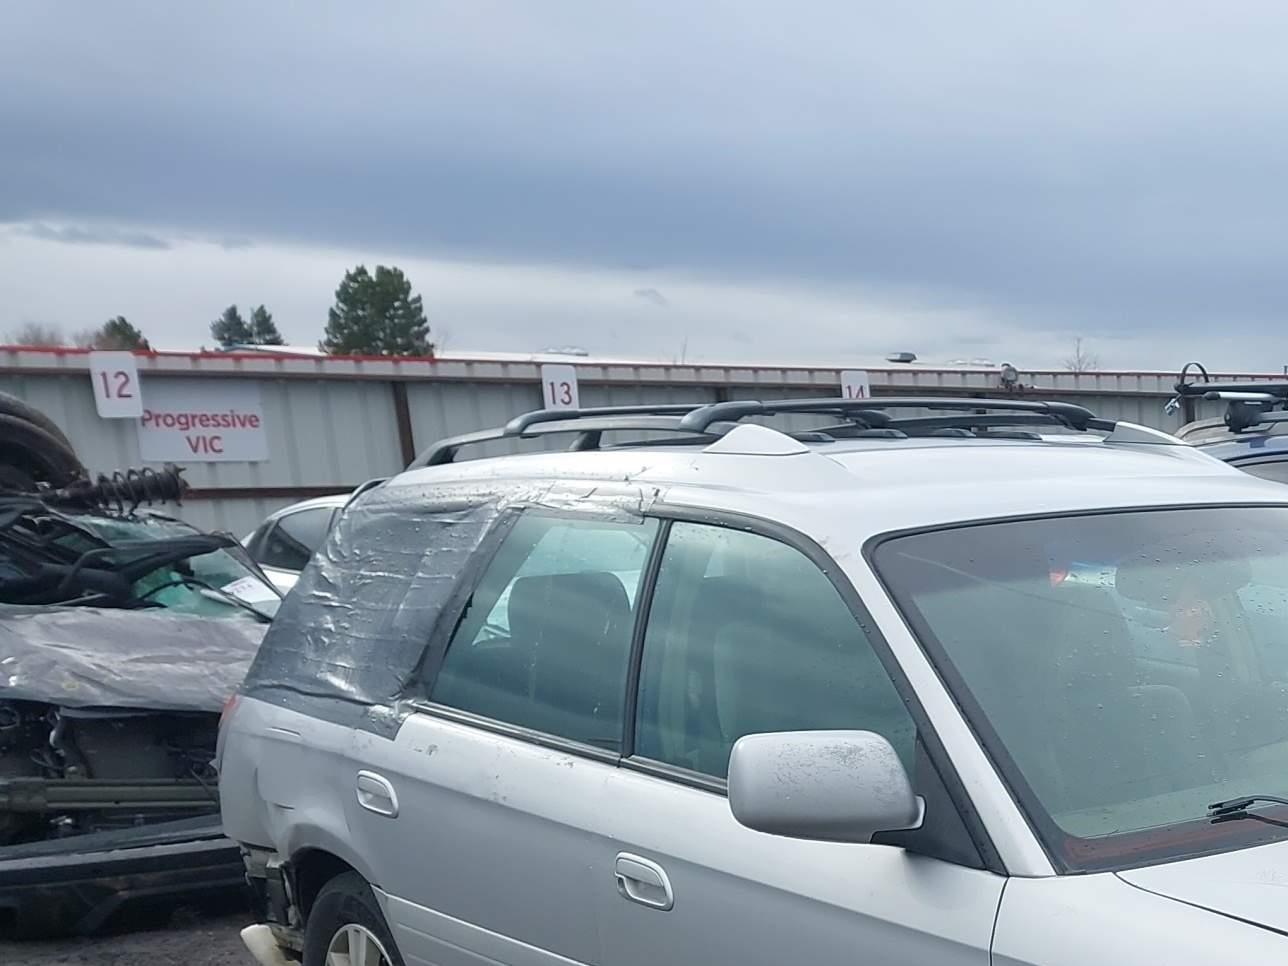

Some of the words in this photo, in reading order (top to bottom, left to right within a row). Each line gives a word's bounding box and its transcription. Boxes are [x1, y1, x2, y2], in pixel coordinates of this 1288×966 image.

[100, 371, 132, 398] 12
[549, 381, 572, 405] 13
[141, 409, 260, 431] Progressive
[186, 435, 223, 454] VIC
